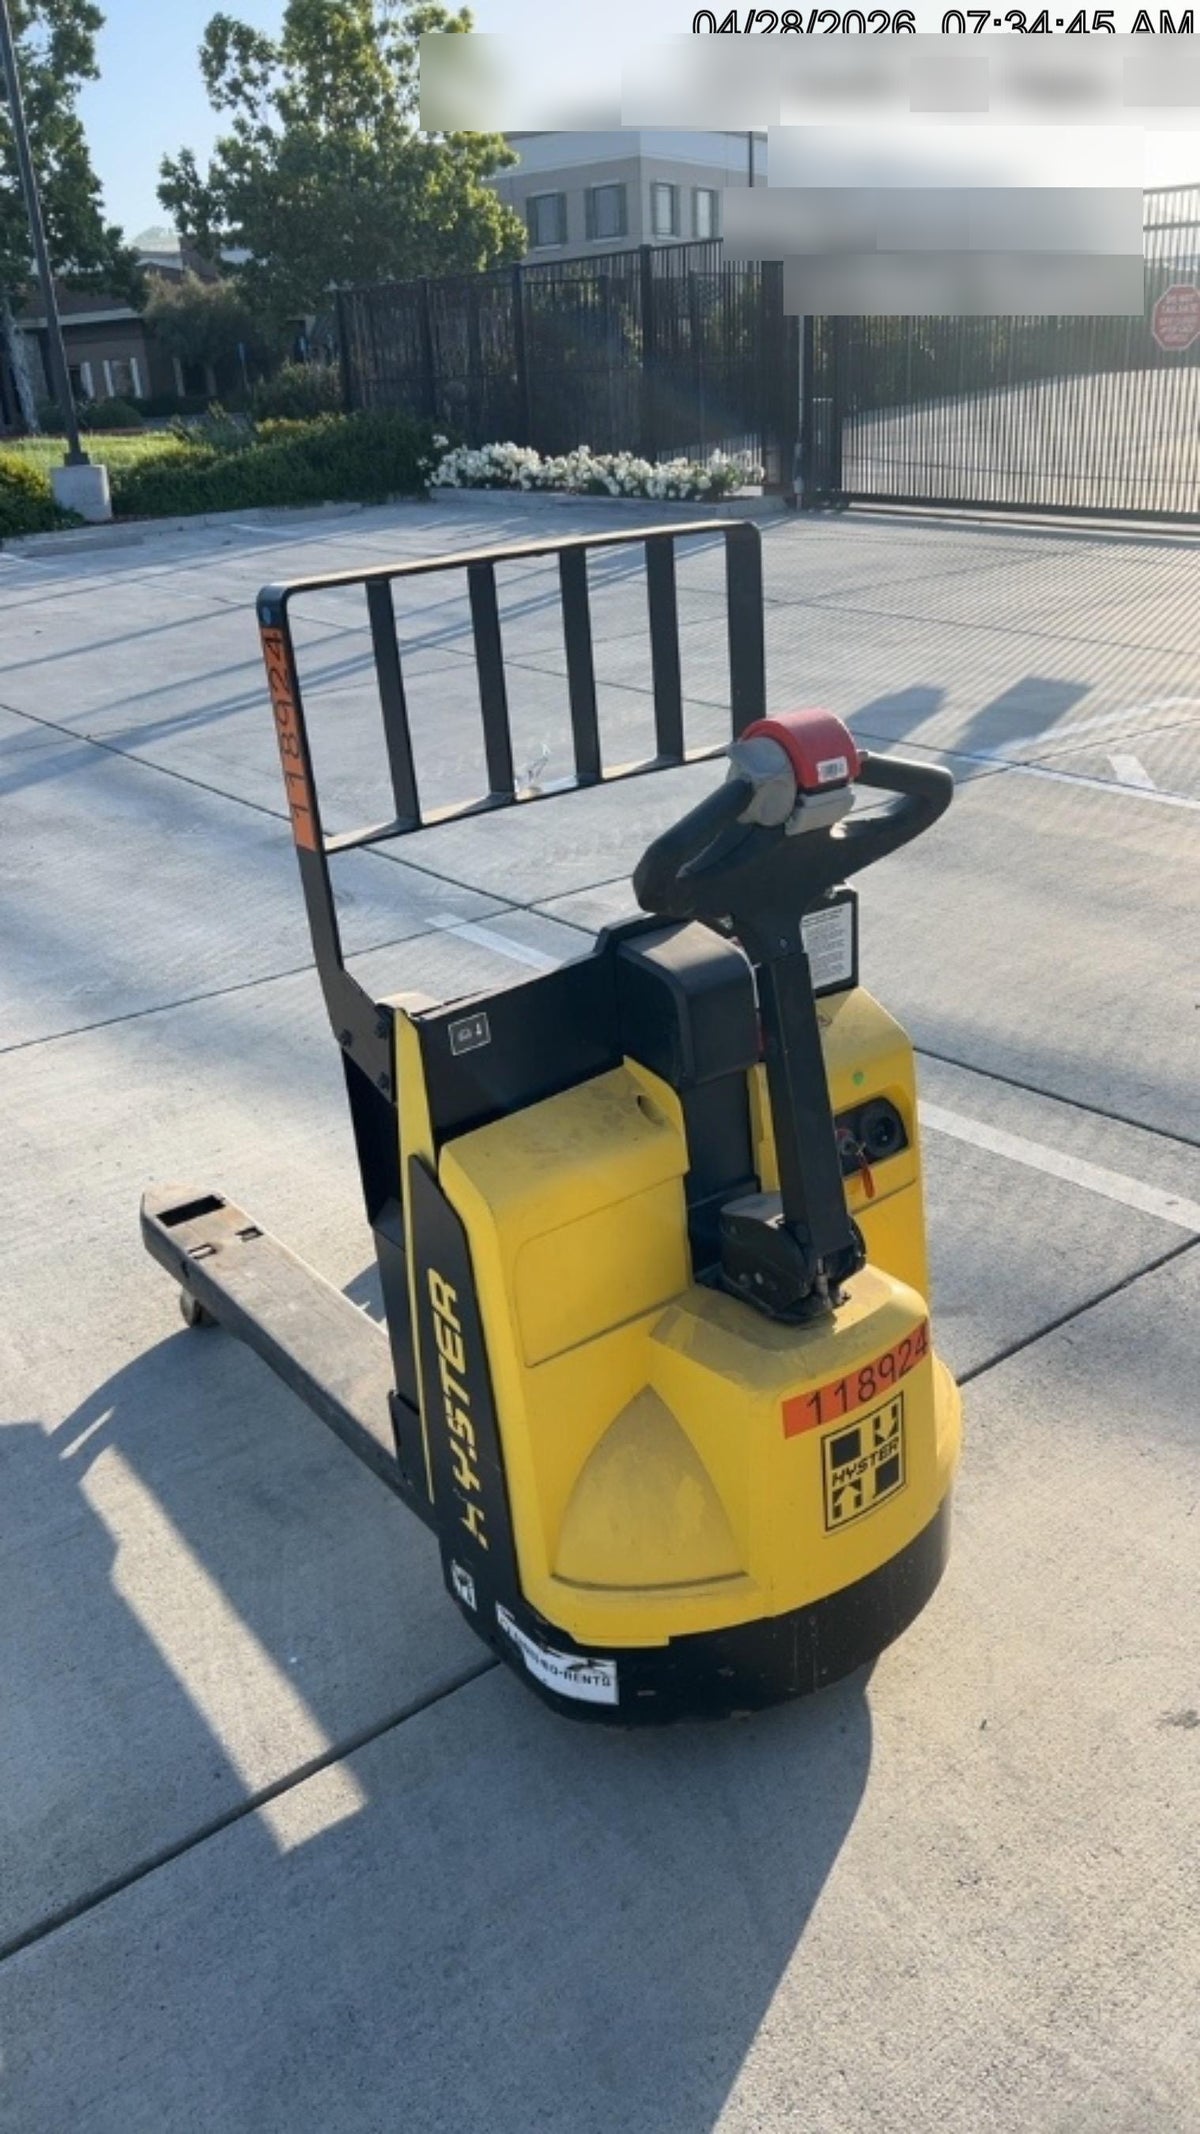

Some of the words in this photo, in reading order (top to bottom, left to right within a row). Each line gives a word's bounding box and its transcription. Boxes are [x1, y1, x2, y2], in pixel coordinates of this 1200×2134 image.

[264, 632, 309, 821] 118924
[427, 1267, 489, 1550] HYSTER
[806, 1323, 929, 1426] 118924
[831, 1439, 900, 1489] HYSTER
